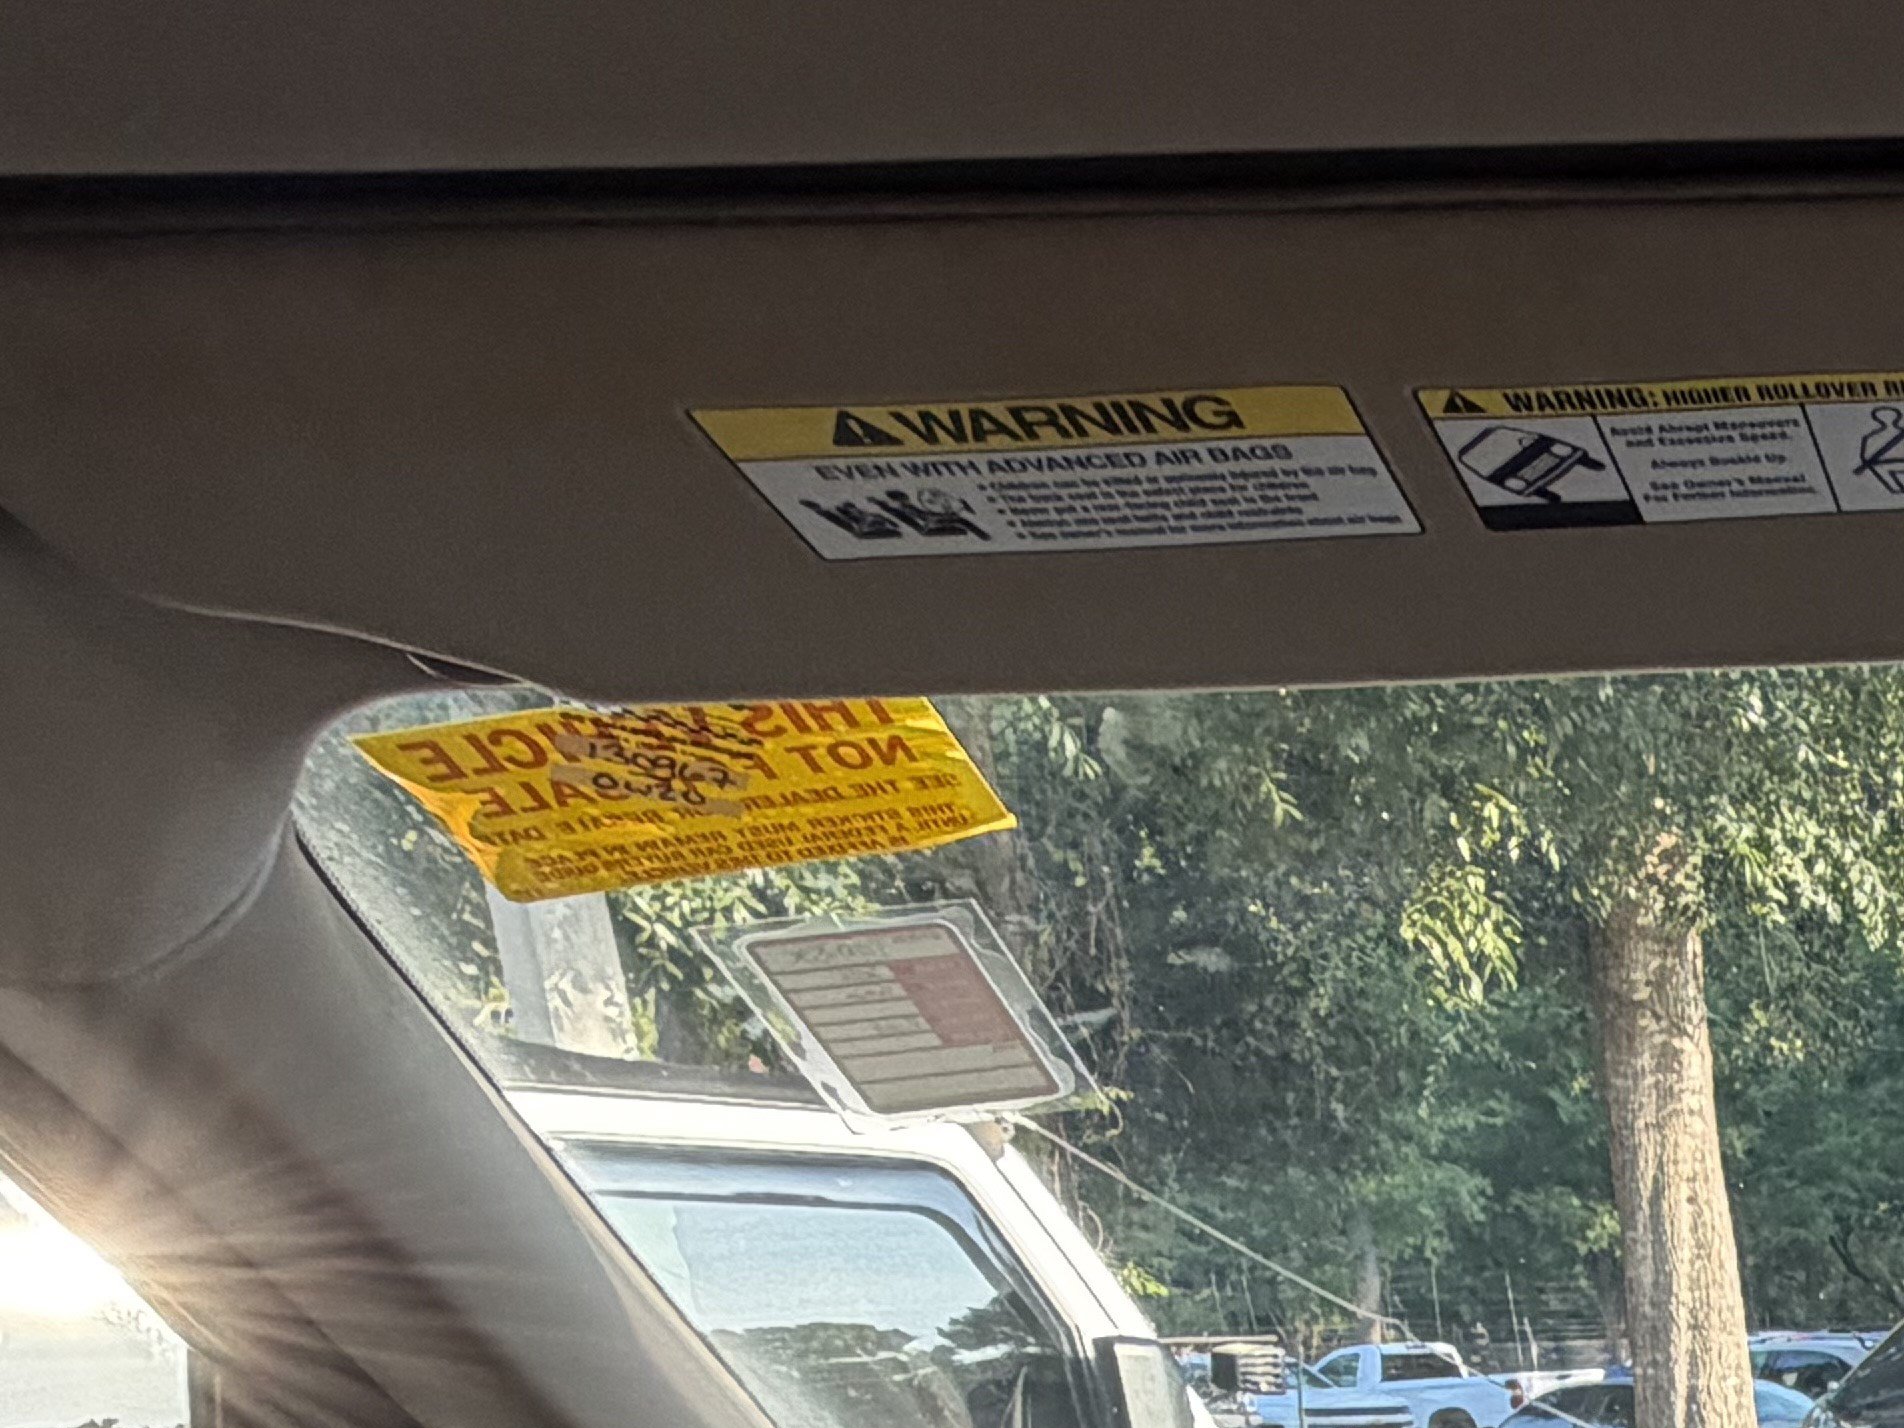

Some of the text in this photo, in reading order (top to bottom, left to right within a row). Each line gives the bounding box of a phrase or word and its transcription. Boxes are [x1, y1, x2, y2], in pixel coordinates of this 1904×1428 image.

[1503, 386, 1657, 413] WARNING:
[1662, 385, 1751, 406] HIGHER
[1756, 379, 1877, 403] ROLLOVER
[891, 395, 1245, 446] WARNING
[814, 460, 902, 482] EVEN
[902, 456, 979, 480] WITH
[986, 450, 1148, 476] ADVANCED
[1154, 448, 1201, 467] AIR
[1208, 443, 1293, 463] BAGS
